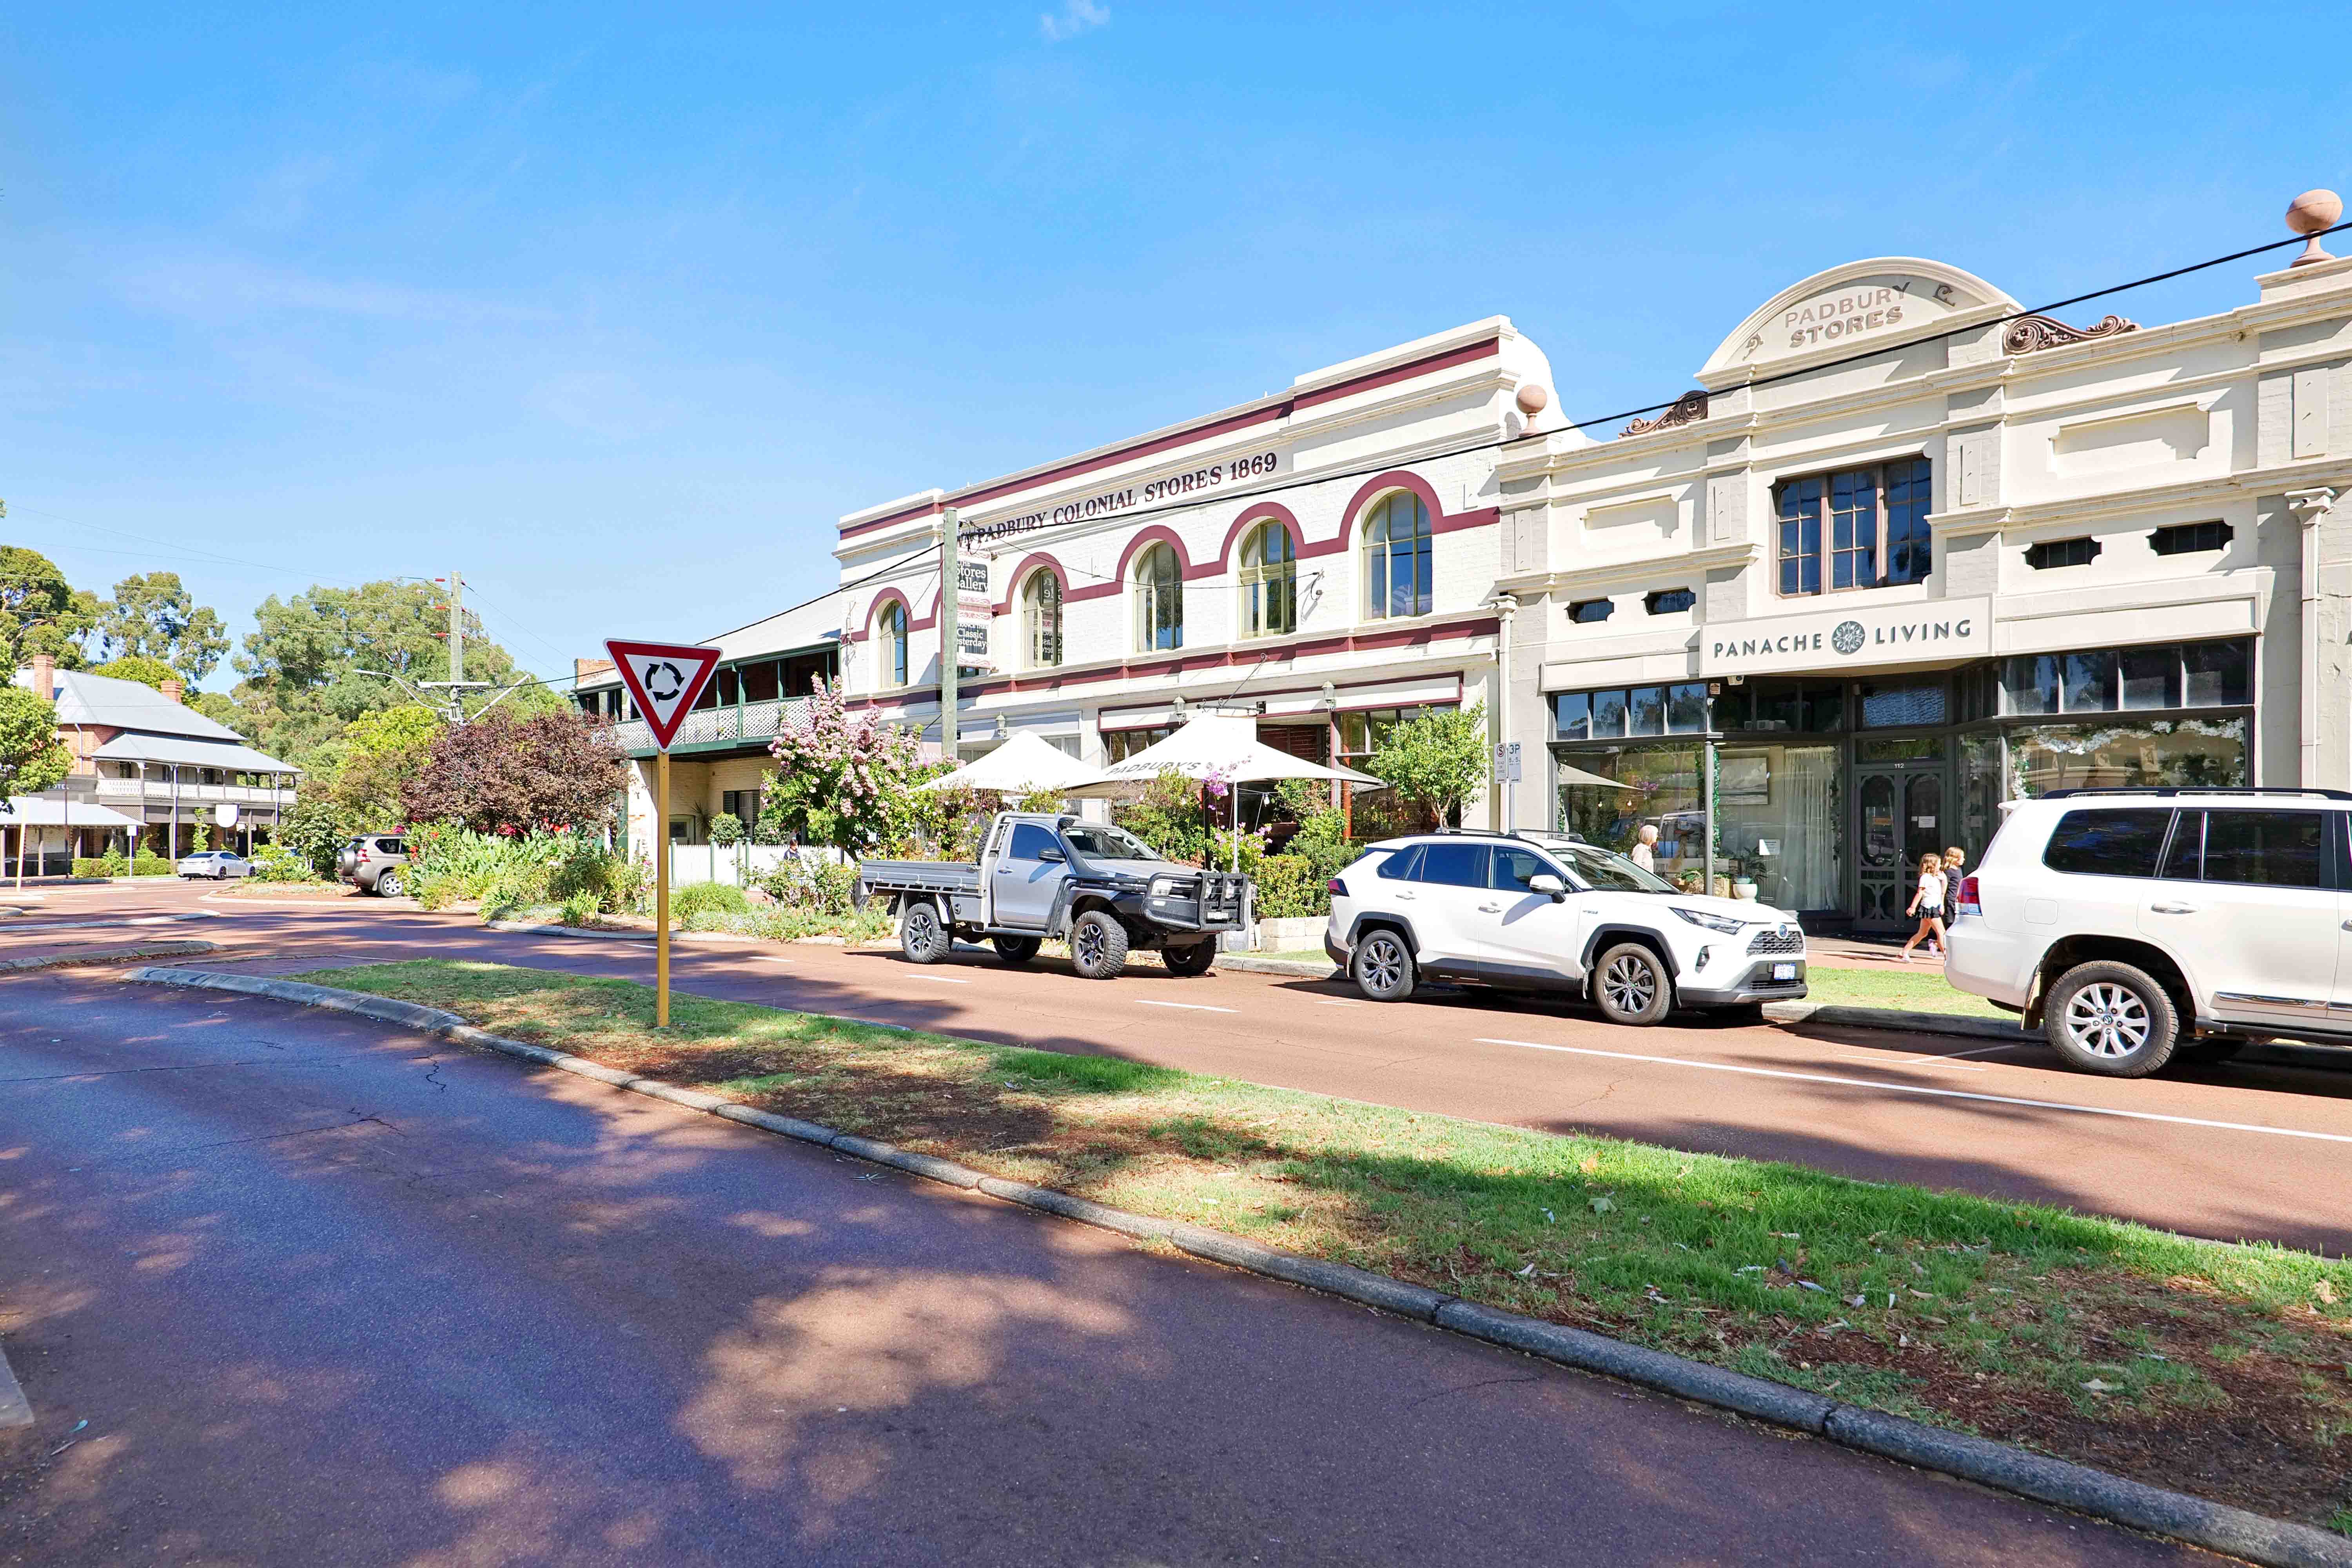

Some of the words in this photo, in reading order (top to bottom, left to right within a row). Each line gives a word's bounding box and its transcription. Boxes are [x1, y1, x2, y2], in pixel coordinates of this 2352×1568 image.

[1784, 281, 1910, 328] PADBURY
[1789, 305, 1904, 348] STORES
[977, 512, 1047, 544] PADBURY
[1053, 489, 1137, 525] COLONIAL
[1144, 466, 1222, 502] STORES
[1229, 452, 1278, 481] 1869
[956, 628, 983, 639] Classic
[1714, 633, 1822, 657] PANACHE
[1875, 619, 1971, 644] LIVING
[1509, 744, 1520, 754] 3P
